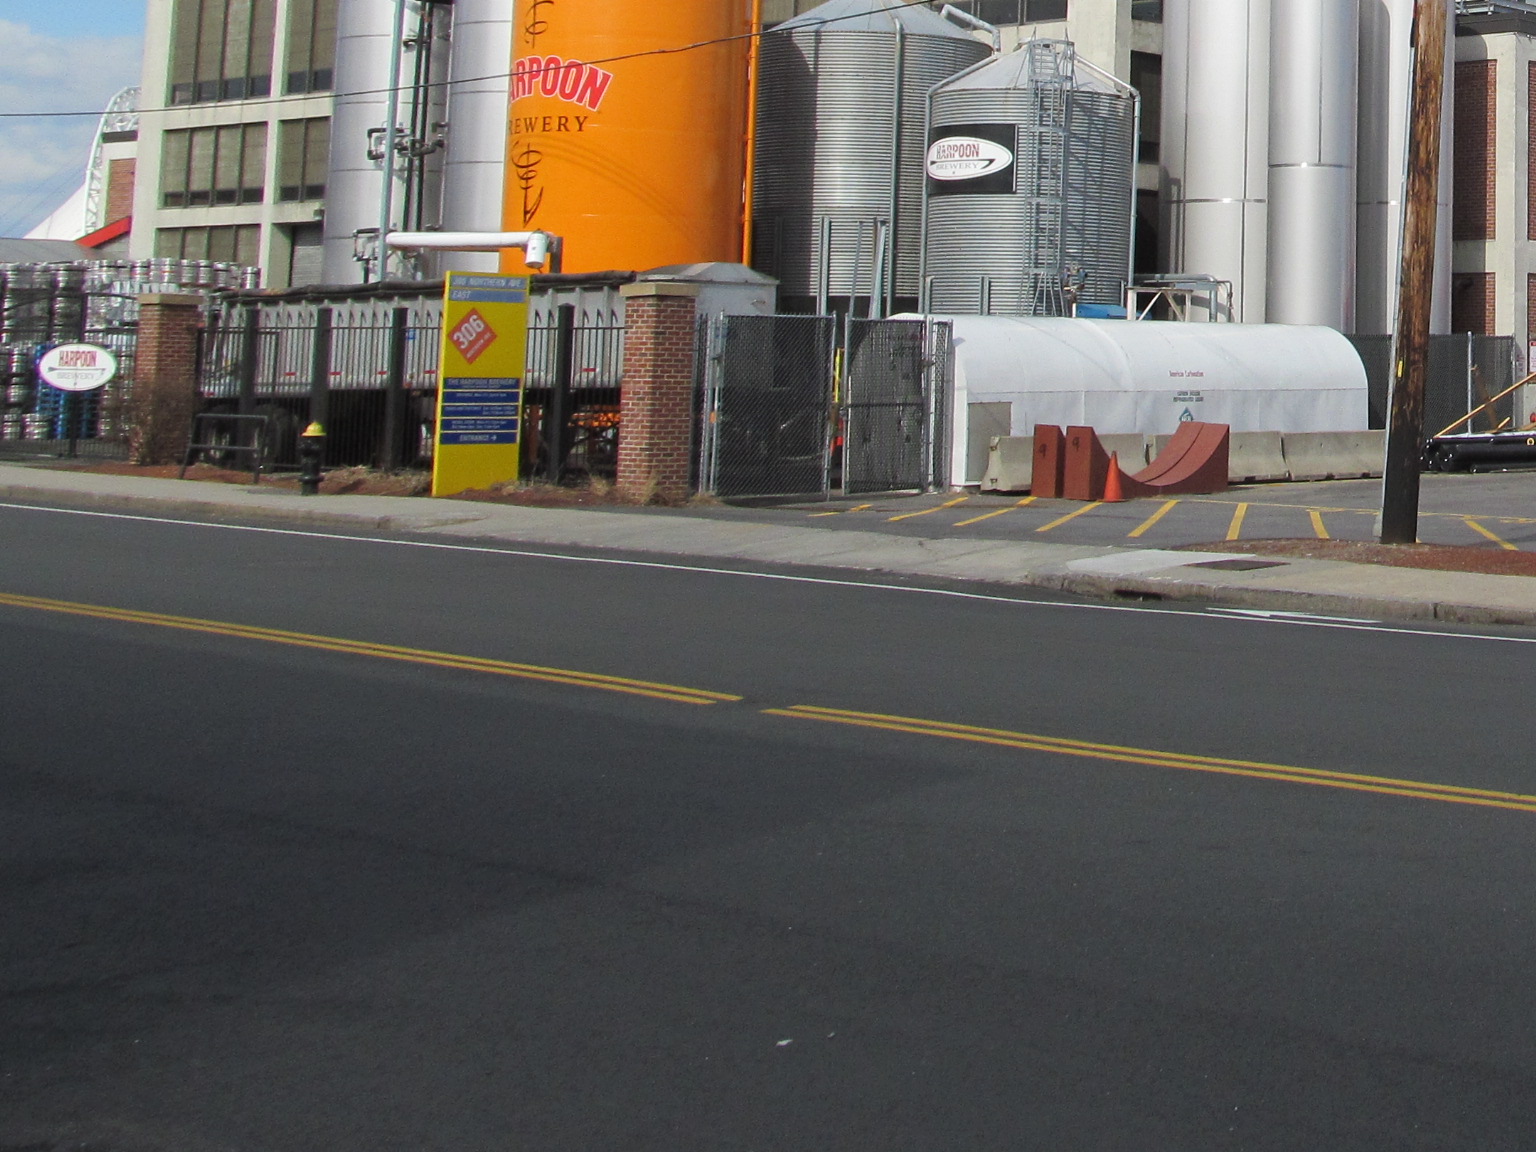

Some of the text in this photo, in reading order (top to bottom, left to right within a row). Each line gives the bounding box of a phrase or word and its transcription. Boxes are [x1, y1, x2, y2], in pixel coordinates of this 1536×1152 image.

[936, 143, 980, 159] HARPOON
[453, 314, 485, 349] 306
[59, 350, 97, 367] HARPOON
